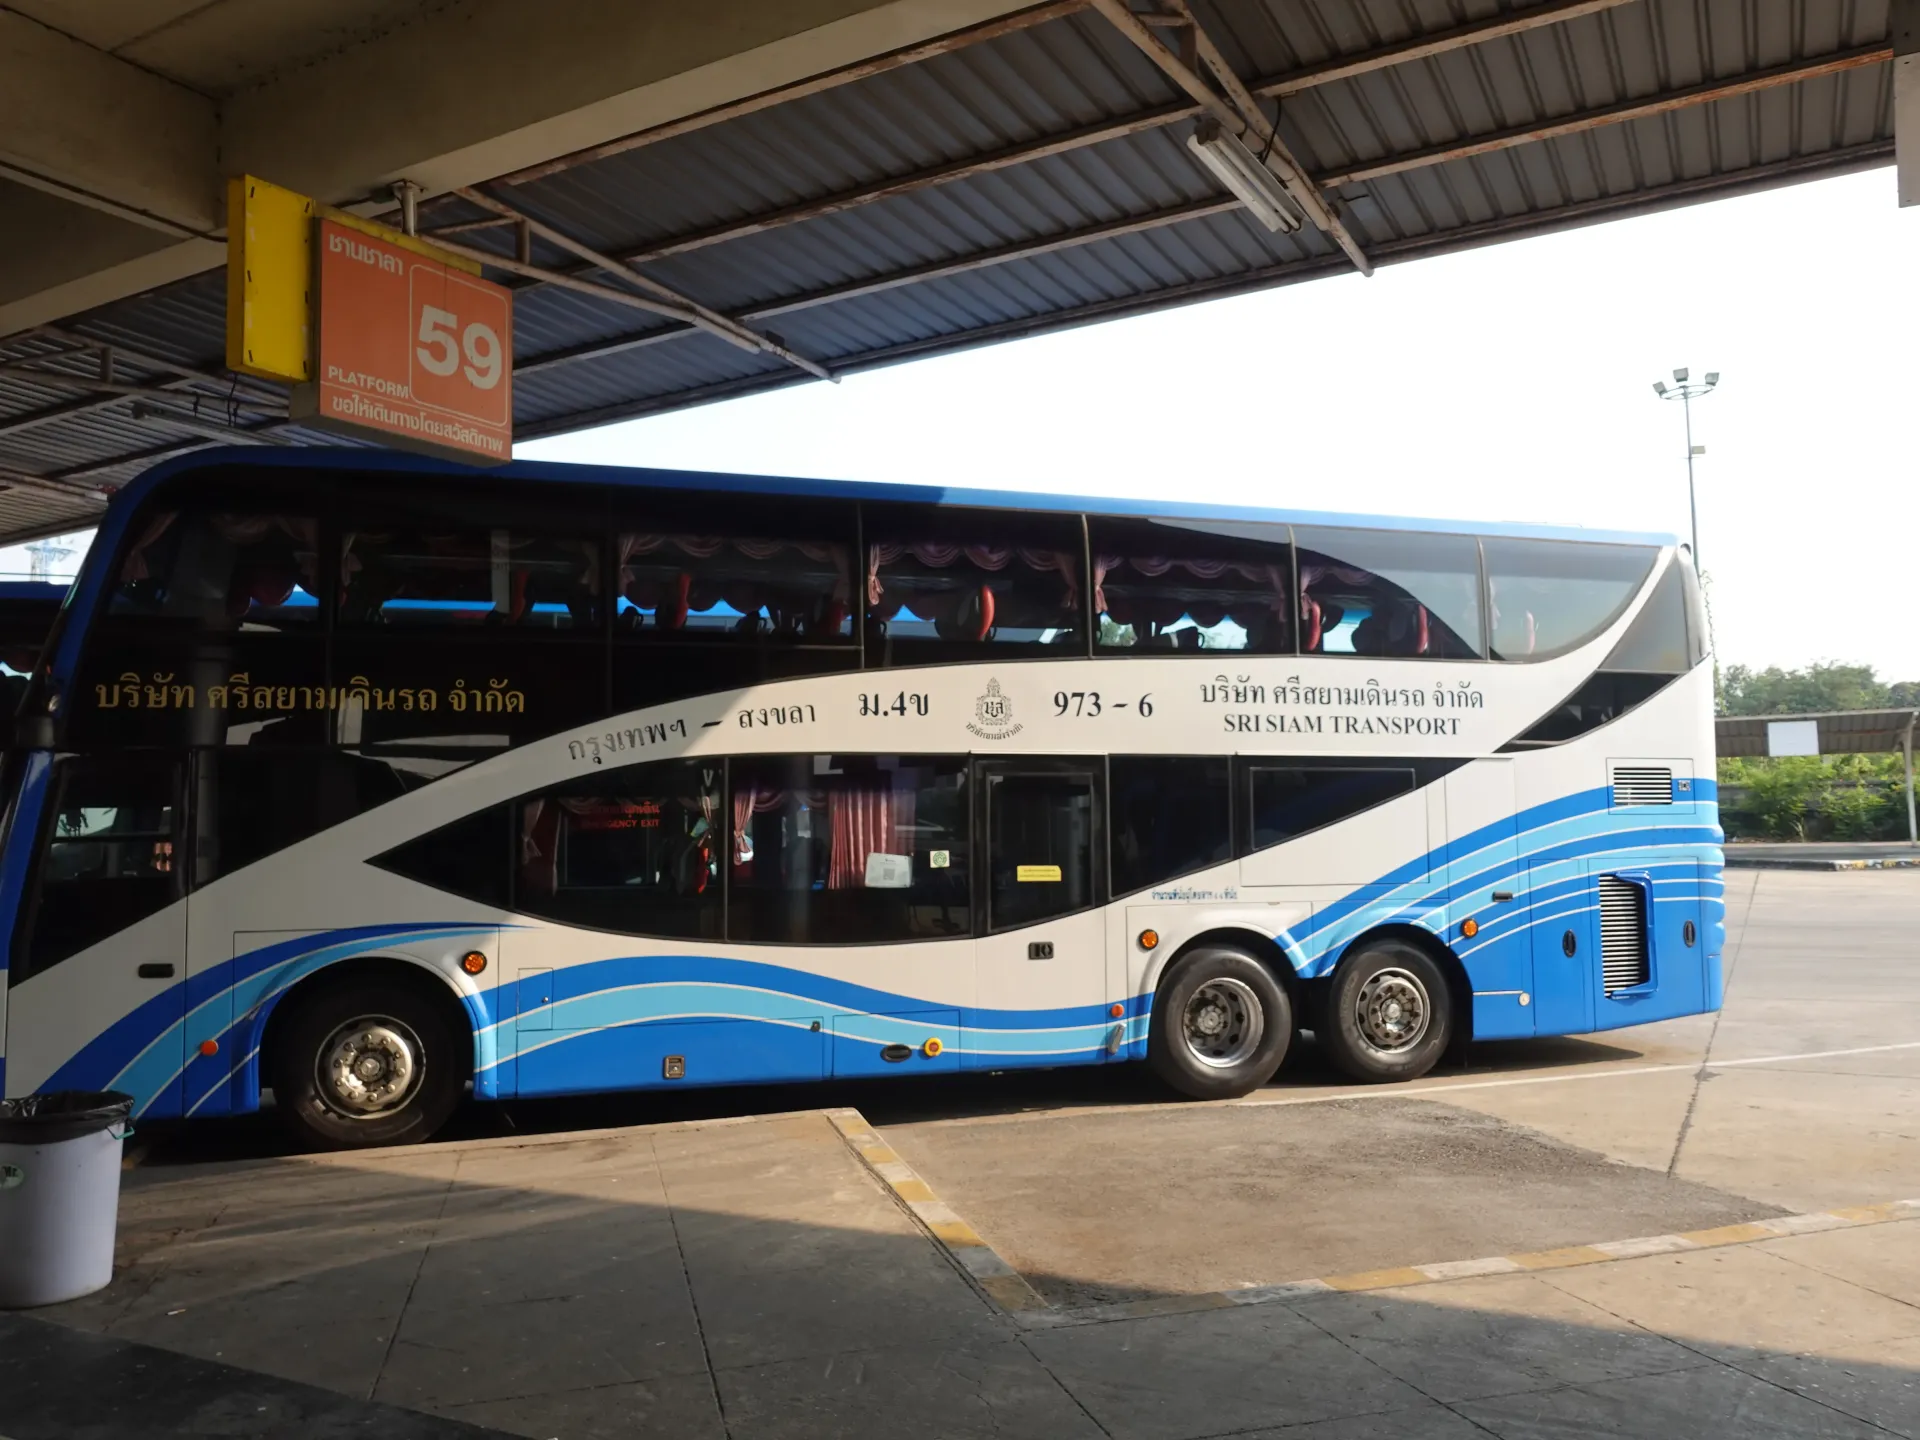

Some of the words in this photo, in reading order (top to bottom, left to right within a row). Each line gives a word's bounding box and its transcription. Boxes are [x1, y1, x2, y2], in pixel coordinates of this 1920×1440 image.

[329, 233, 404, 276] ชานชาลา
[416, 304, 503, 390] 59
[328, 365, 410, 399] PLATFORM
[96, 671, 195, 709] บริษัท
[448, 677, 525, 713] จำกัด
[858, 691, 930, 717] ม.4ข
[1054, 691, 1103, 718] 973
[1138, 692, 1154, 718] 6
[1199, 674, 1266, 704] บริษัท
[1274, 676, 1425, 708] ศรีสยามเดินรถ
[1432, 681, 1484, 709] จำกัด
[567, 718, 687, 765] กรุงเทพฯ
[738, 703, 816, 729] สงขลา
[1223, 713, 1262, 733] SRI
[1265, 713, 1324, 734] SIAM
[1329, 715, 1461, 735] TRANSPORT
[641, 819, 661, 828] EXIT
